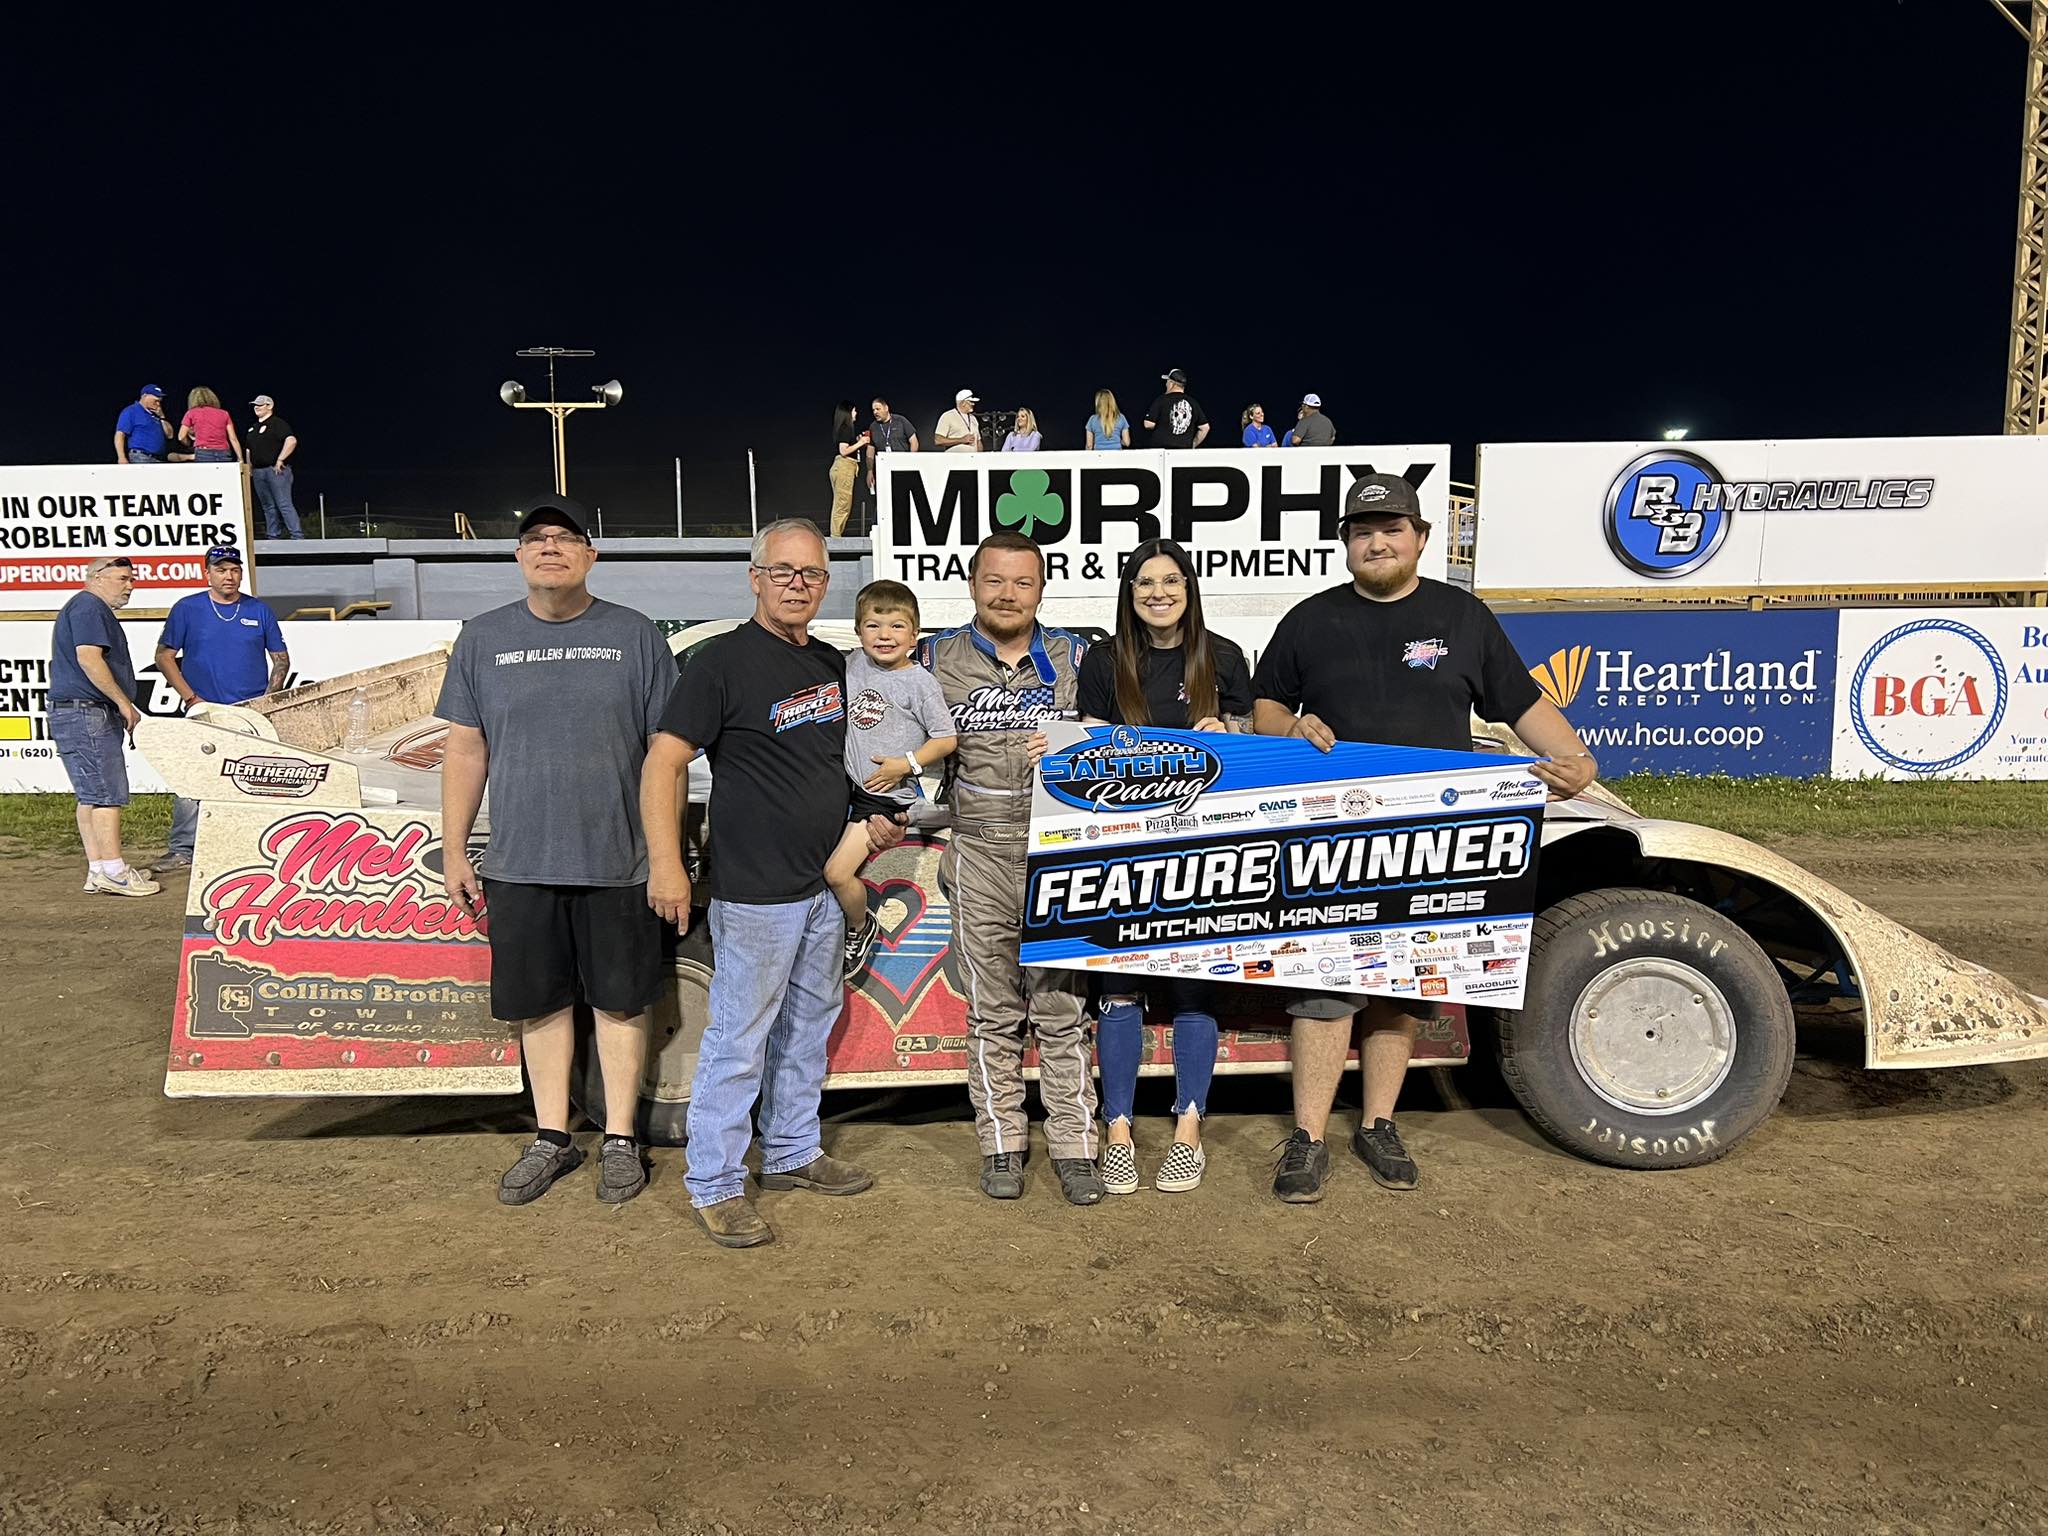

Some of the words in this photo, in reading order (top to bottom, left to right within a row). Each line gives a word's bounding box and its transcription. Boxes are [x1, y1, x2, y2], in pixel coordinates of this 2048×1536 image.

[1693, 480, 1934, 511] HYDRAULICS
[0, 496, 29, 519] IN
[38, 495, 98, 518] OUR
[104, 494, 181, 518] TEAM
[187, 493, 223, 516] OF
[890, 464, 1437, 546] MURPHY
[114, 522, 237, 548] SOLVERS
[894, 553, 1070, 582] TRAR
[1082, 551, 1104, 580] &
[1118, 549, 1336, 580] EIPMENT
[495, 651, 524, 667] TANNER
[526, 648, 563, 662] MULLENS
[565, 647, 622, 661] MOTORSPORTS
[0, 659, 52, 684] CTI
[1596, 650, 1818, 692] Heartland
[970, 687, 1023, 710] Mel
[1597, 693, 1700, 707] CREDIT
[1723, 693, 1814, 706] UNION
[1871, 673, 1986, 717] BGA
[950, 703, 1062, 726] Hambelton
[2010, 734, 2038, 745] Your
[20, 747, 53, 759] (620)
[1998, 754, 2025, 766] your
[223, 760, 327, 781] DEATHERAGE
[238, 775, 268, 783] RACING
[270, 777, 312, 786] OPTICIANS
[1497, 781, 1520, 791] Mel
[1086, 776, 1209, 814] Racing
[1490, 788, 1543, 800] Hambelton
[1259, 800, 1297, 812] EVANS
[1146, 818, 1170, 832] Pizza
[1171, 815, 1199, 828] Ranch
[1202, 810, 1256, 822] MURPHY
[1102, 822, 1141, 833] CENTRAL
[267, 818, 424, 885] Mel
[1036, 847, 1274, 917] FEATURE
[1289, 822, 1529, 888] WINNER
[1117, 910, 1275, 942] HUTCHINSON,
[1279, 902, 1380, 928] KANSAS
[1409, 890, 1487, 916] 2025
[1493, 922, 1529, 930] KanEquip
[1350, 934, 1379, 946] apac
[1440, 930, 1462, 940] Kansas
[1462, 929, 1471, 938] BG
[1587, 917, 1729, 958] Hoosier
[1235, 941, 1266, 952] Quality
[1411, 945, 1458, 958] ANDALE
[1111, 953, 1149, 964] AutoZone
[1210, 965, 1239, 974] LOWEN
[258, 981, 364, 1002] Collins
[1422, 983, 1446, 991] HUTCH
[1464, 979, 1518, 991] BRADBURY
[297, 1022, 323, 1031] OF
[1580, 1117, 1721, 1157] Hoosier
